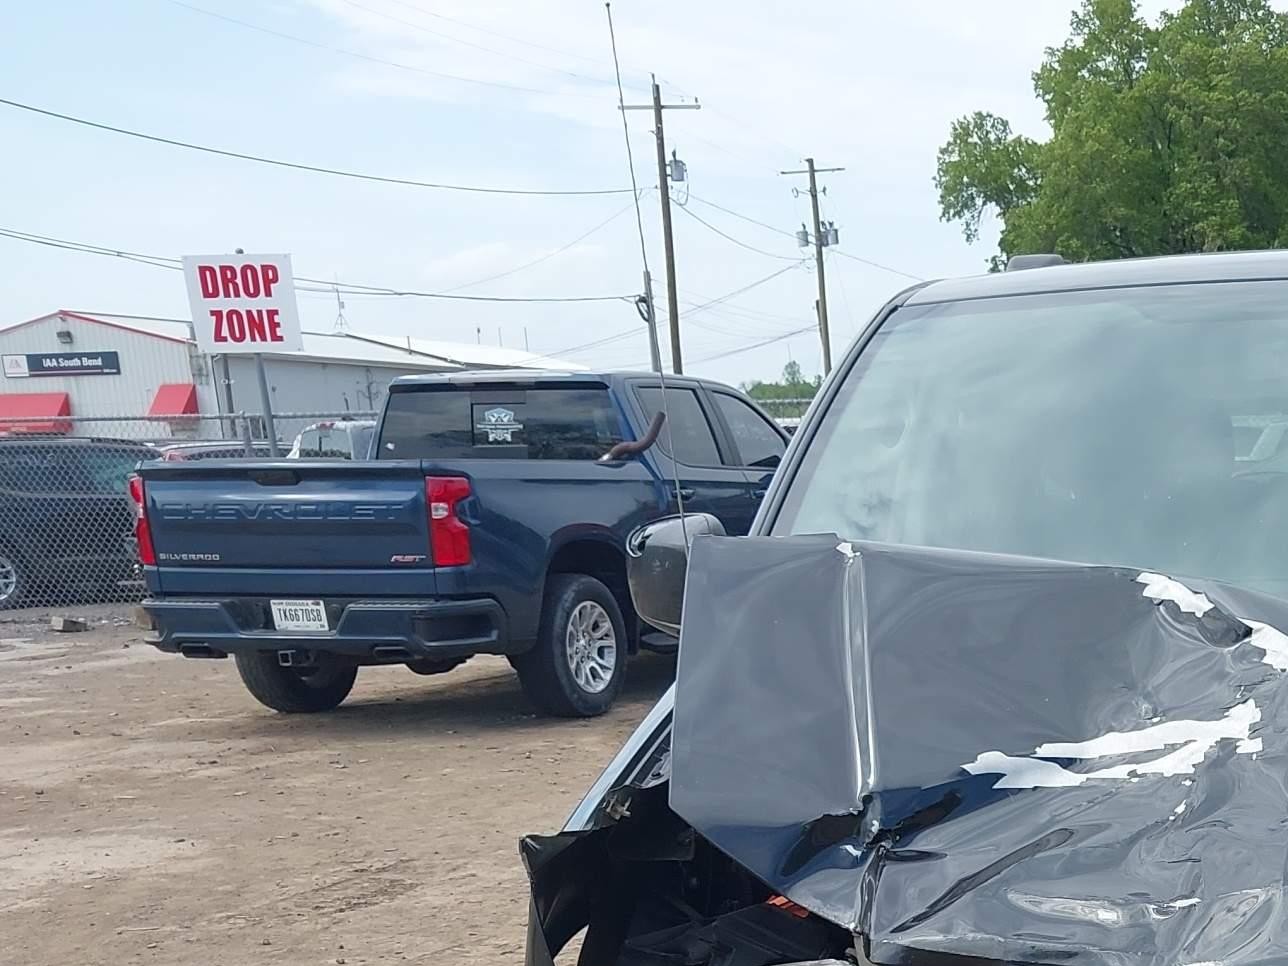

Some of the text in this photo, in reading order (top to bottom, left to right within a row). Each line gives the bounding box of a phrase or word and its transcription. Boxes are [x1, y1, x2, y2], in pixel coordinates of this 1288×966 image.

[197, 264, 279, 299] DROP
[209, 308, 285, 343] ZONE
[42, 356, 103, 368] IAA South Bend
[160, 503, 405, 520] CHEVROLET
[159, 553, 220, 561] SILVERADO
